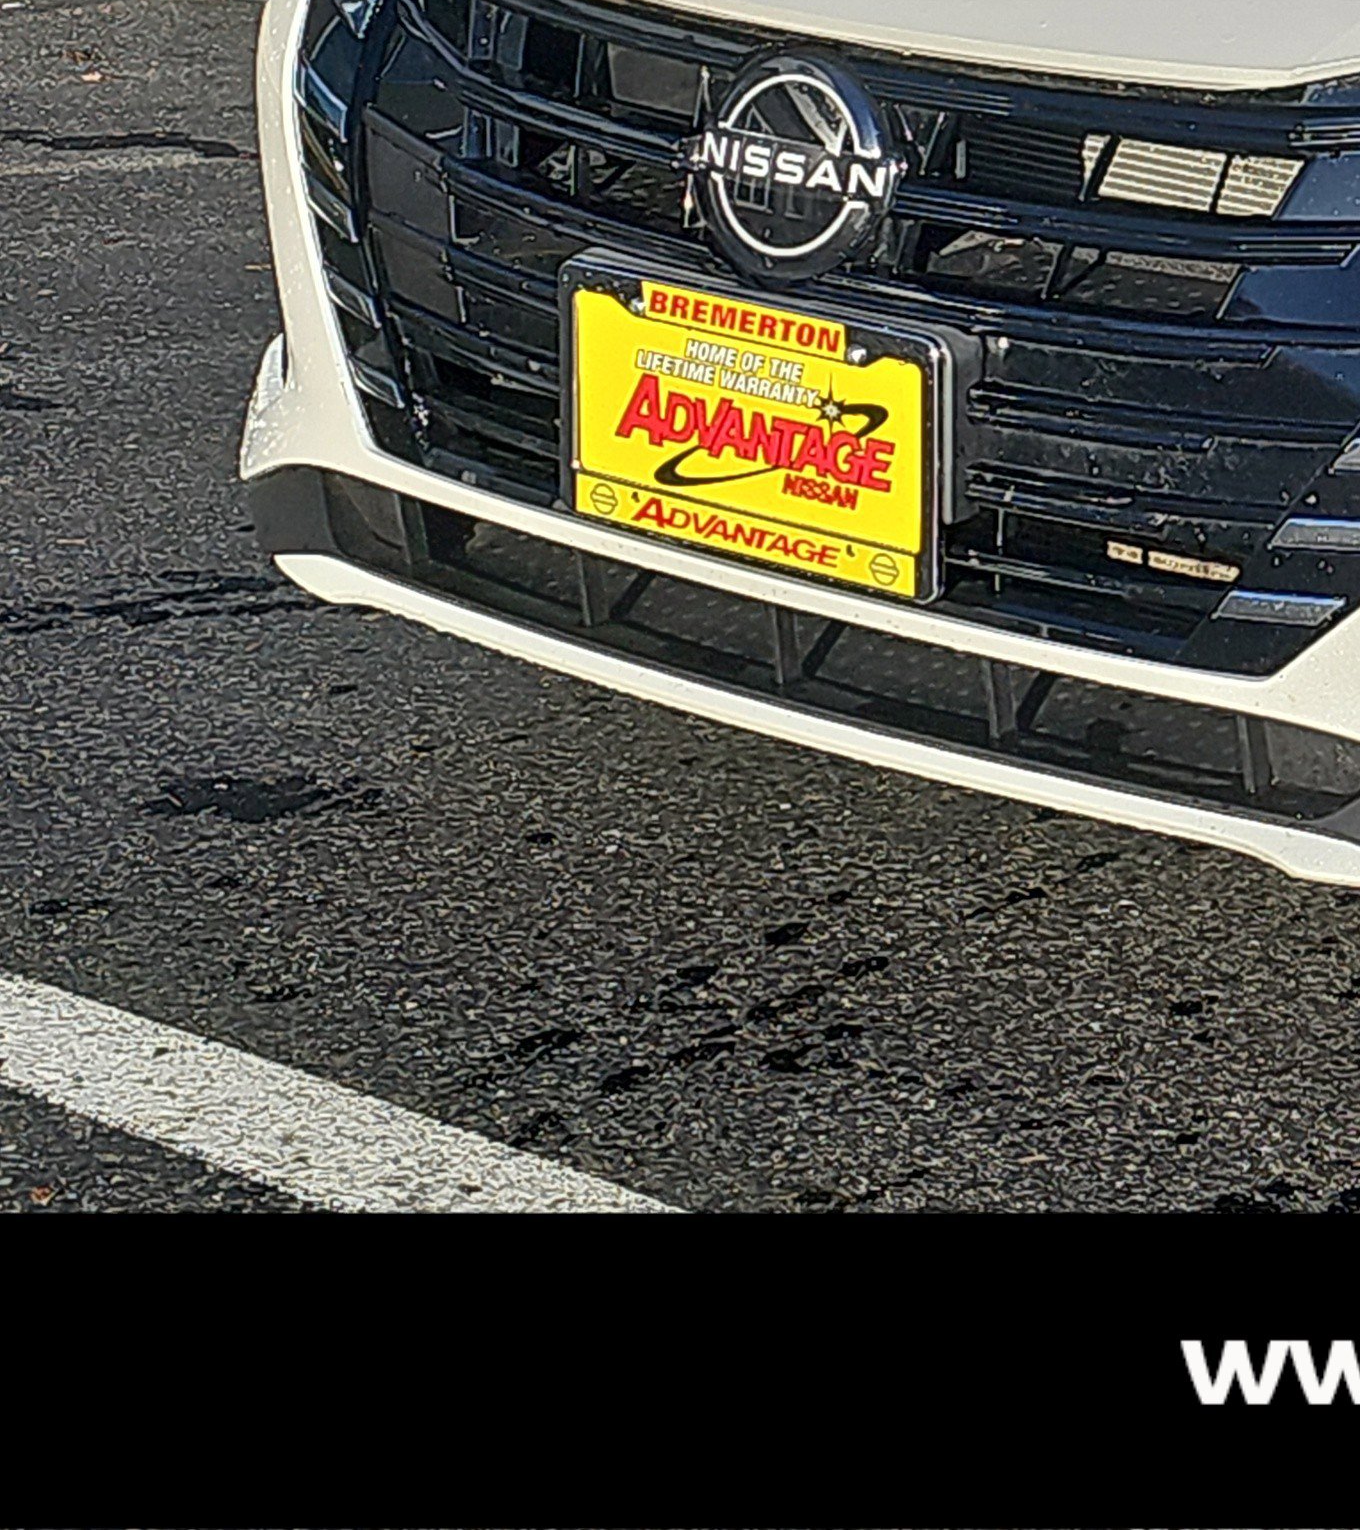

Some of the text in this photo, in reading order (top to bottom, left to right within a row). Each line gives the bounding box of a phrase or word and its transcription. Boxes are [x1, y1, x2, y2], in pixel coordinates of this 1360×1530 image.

[700, 131, 886, 197] NISSAN
[649, 290, 841, 353] BREMERTON
[636, 350, 820, 408] LIFETIME WARRANTY
[686, 339, 804, 383] HOME OF THE
[615, 373, 896, 493] ADVANTAGE
[782, 473, 860, 511] NISSAN
